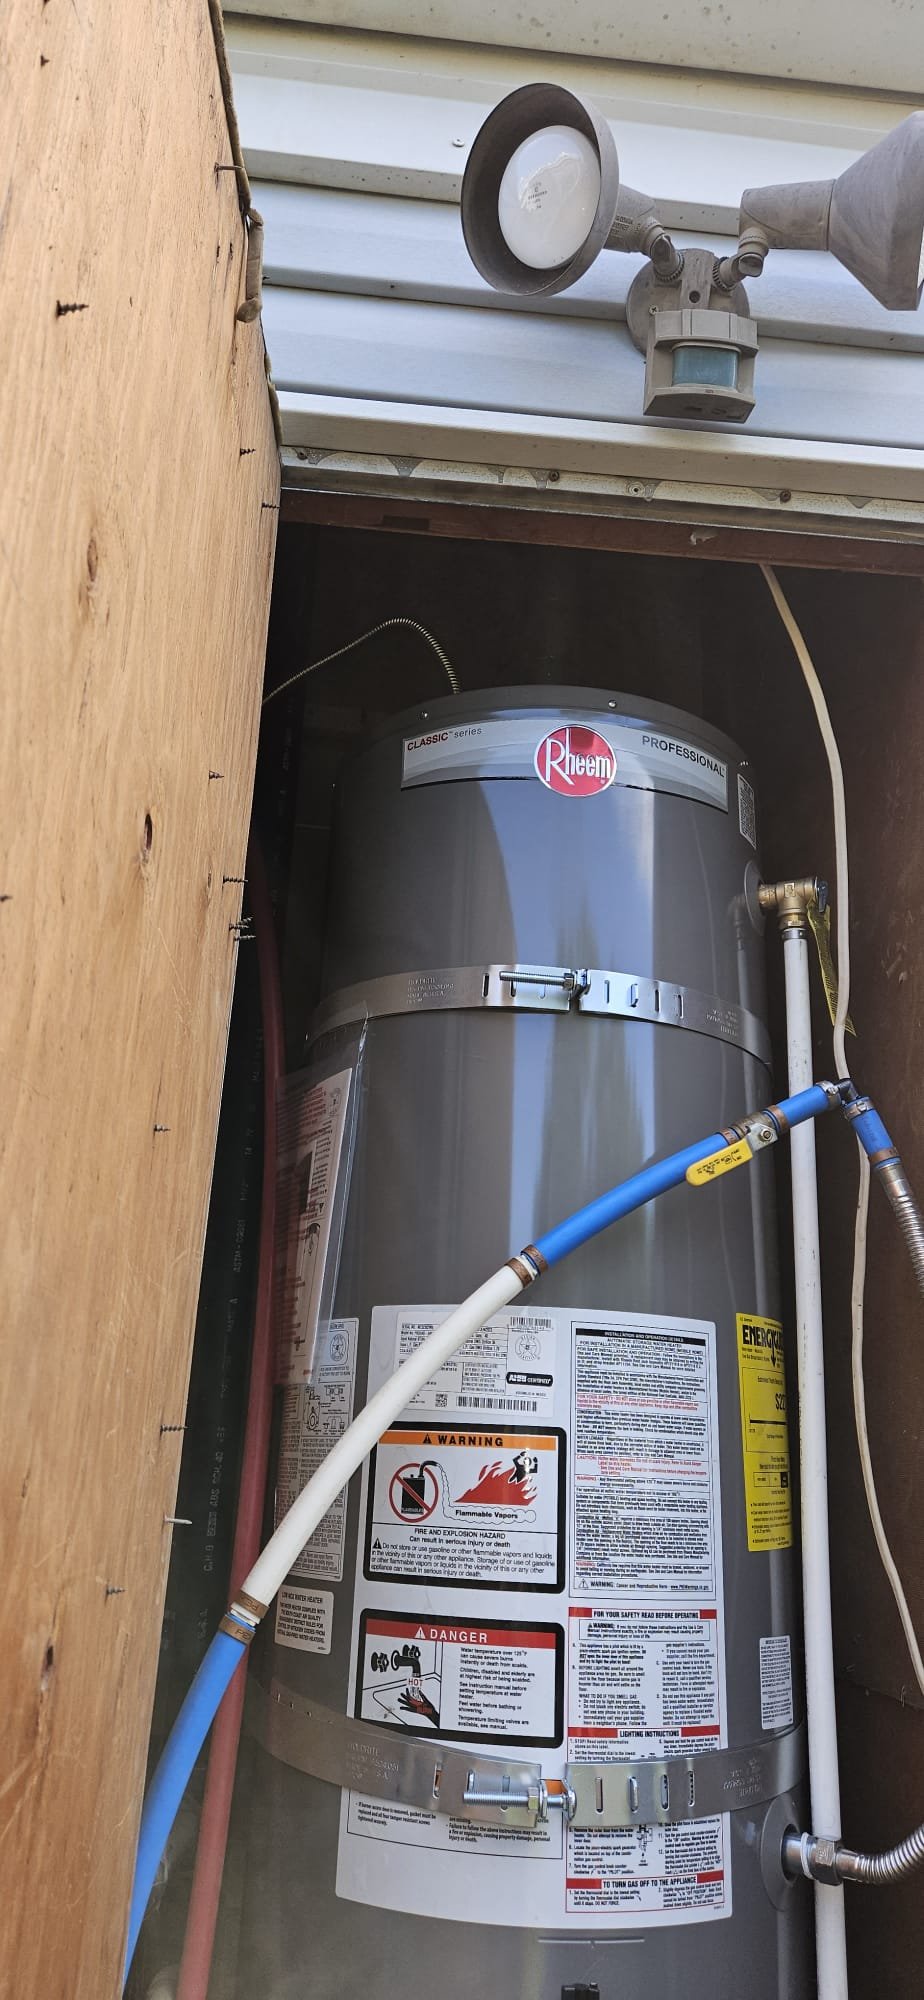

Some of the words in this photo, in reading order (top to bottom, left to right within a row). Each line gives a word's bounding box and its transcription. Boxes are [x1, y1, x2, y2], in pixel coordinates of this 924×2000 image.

[454, 728, 482, 738] series
[545, 728, 611, 785] Rheem
[642, 736, 724, 777] PROFESSIONAL
[438, 1435, 504, 1447] WARNING
[456, 1510, 492, 1518] Flammable
[429, 1546, 450, 1554] gasoline
[535, 1553, 552, 1561] liquids
[477, 1557, 499, 1565] Storage
[371, 1564, 392, 1572] appliance
[474, 1564, 494, 1572] vicinity
[430, 1629, 487, 1643] DANGER
[612, 1880, 626, 1888] TURN
[628, 1879, 638, 1887] GAS
[652, 1878, 657, 1886] TO
[670, 1876, 696, 1885] APPLIANCE
